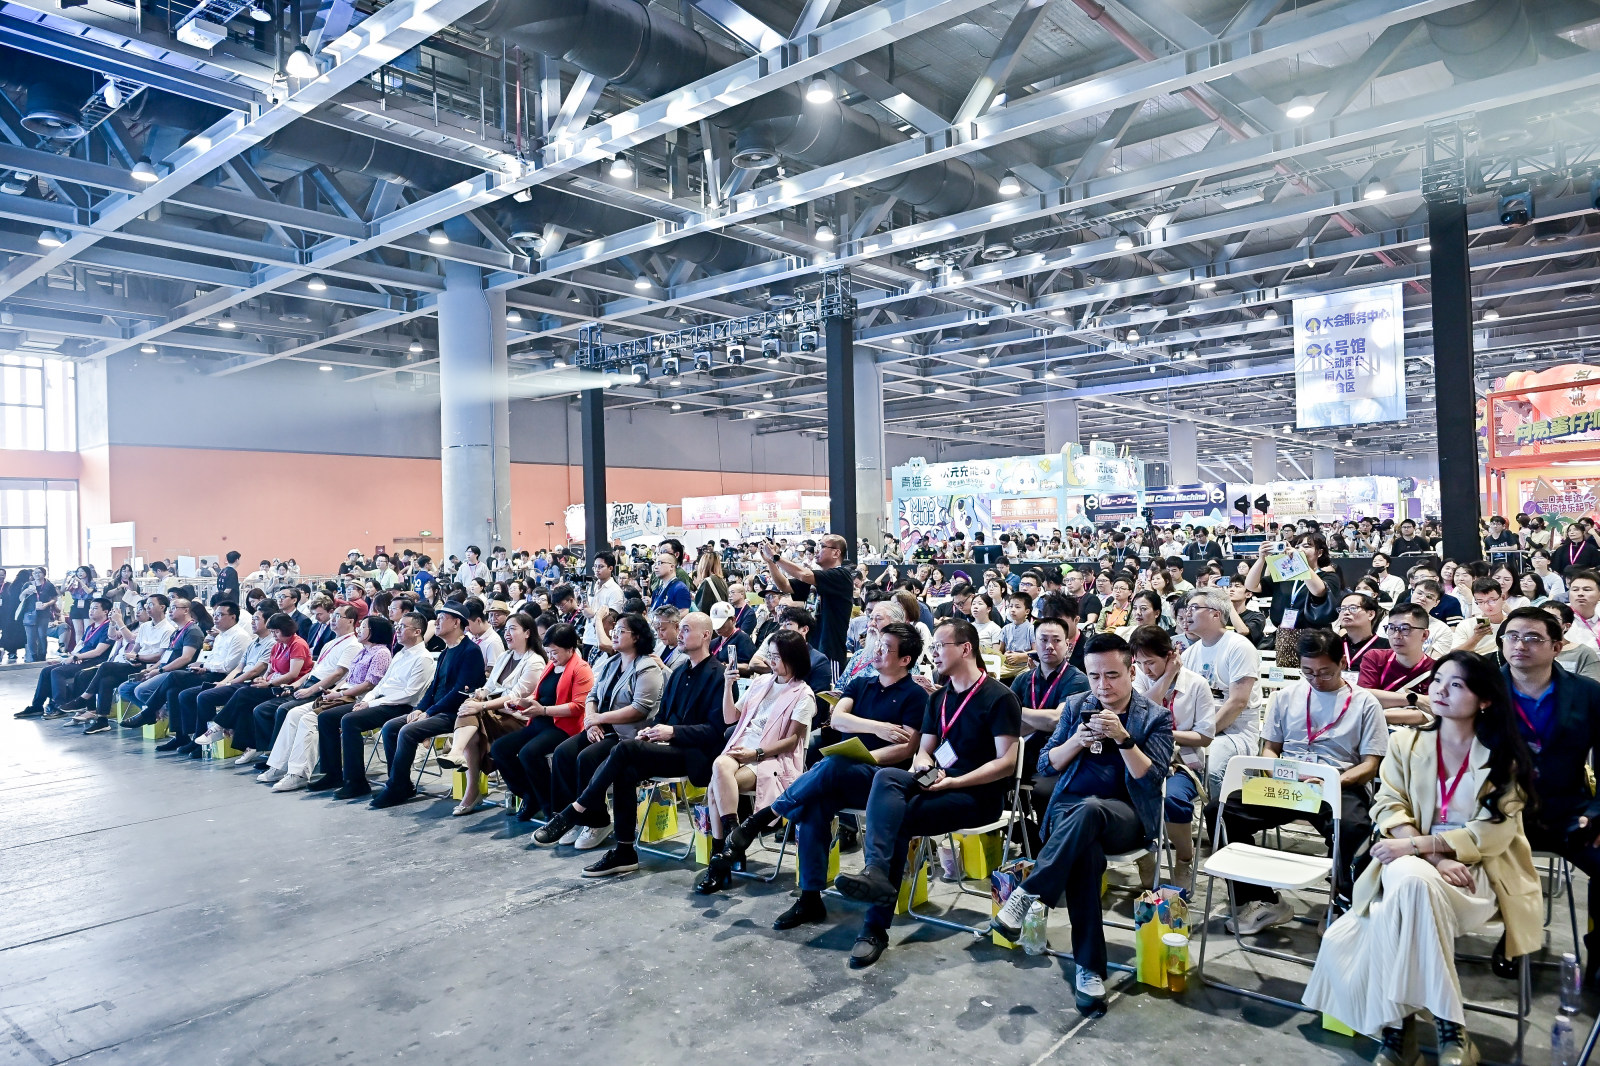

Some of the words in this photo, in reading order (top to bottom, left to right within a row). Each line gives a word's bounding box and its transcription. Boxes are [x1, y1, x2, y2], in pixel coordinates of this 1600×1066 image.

[1323, 308, 1390, 329] 大会服务中心
[1324, 338, 1366, 356] 6号馆
[1324, 369, 1356, 382] 同人区
[1326, 381, 1356, 394] 食区
[902, 475, 932, 488] 青猫会
[1176, 493, 1206, 502] Machine
[612, 503, 635, 517] RJR
[909, 498, 936, 511] MIAO
[910, 511, 936, 525] CLUB
[1277, 768, 1295, 779] 021
[1263, 786, 1303, 802] 温绍伦
